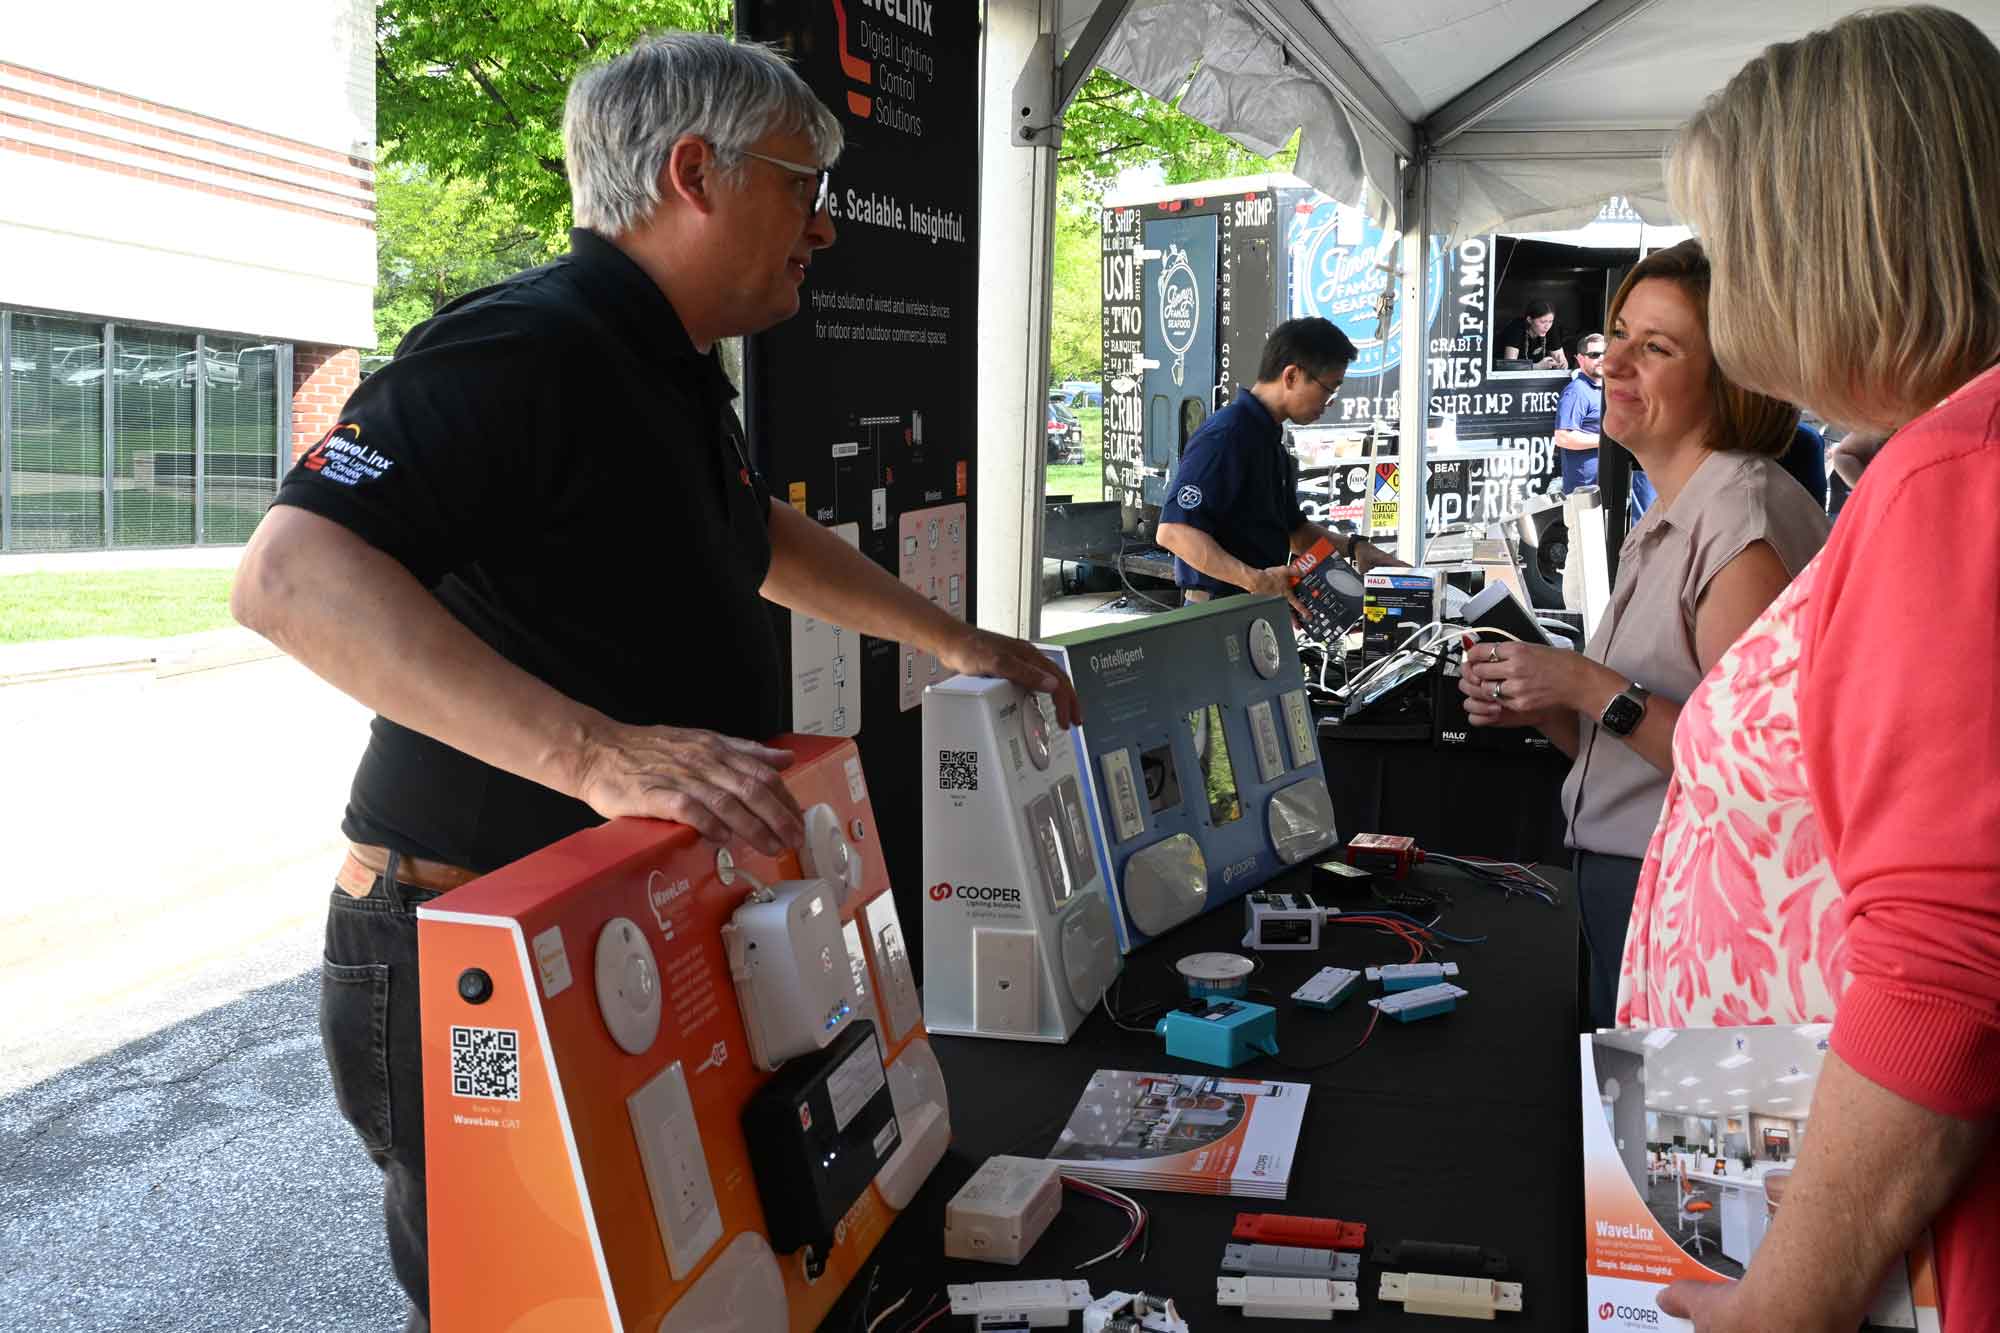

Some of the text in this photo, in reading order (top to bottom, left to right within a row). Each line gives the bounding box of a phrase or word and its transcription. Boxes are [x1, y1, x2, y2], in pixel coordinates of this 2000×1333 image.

[860, 20, 933, 82] Digital Lighting
[880, 63, 916, 101] Control
[876, 96, 921, 136] Solutions
[846, 188, 906, 230] Scalable.
[909, 203, 966, 244] Insightful.
[1115, 209, 1135, 233] SHIP
[1235, 197, 1272, 227] SHRIMP
[1223, 202, 1232, 326] SENSATION
[1103, 254, 1134, 301] USA
[810, 289, 836, 312] Hybrid
[837, 290, 864, 310] solution
[874, 296, 892, 313] wired
[892, 297, 905, 314] and
[1331, 293, 1381, 315] SEAFO
[815, 320, 827, 339] for
[828, 320, 850, 339] indoor
[851, 322, 865, 340] and
[865, 322, 891, 341] outdoor
[1111, 306, 1142, 335] TWO
[1110, 339, 1142, 353] BANQUET
[1110, 394, 1142, 433] CRAB
[1429, 393, 1513, 417] SHRIMP
[1521, 392, 1560, 413] FRIES
[1110, 433, 1142, 463] CAKES
[331, 460, 362, 479] Control
[1434, 463, 1461, 473] BEAT
[1099, 645, 1145, 670] intelligent
[1442, 731, 1466, 740] HALO
[956, 885, 1022, 902] COOPER
[1595, 1220, 1655, 1241] WaveLinx
[1617, 1305, 1659, 1324] COOPER
